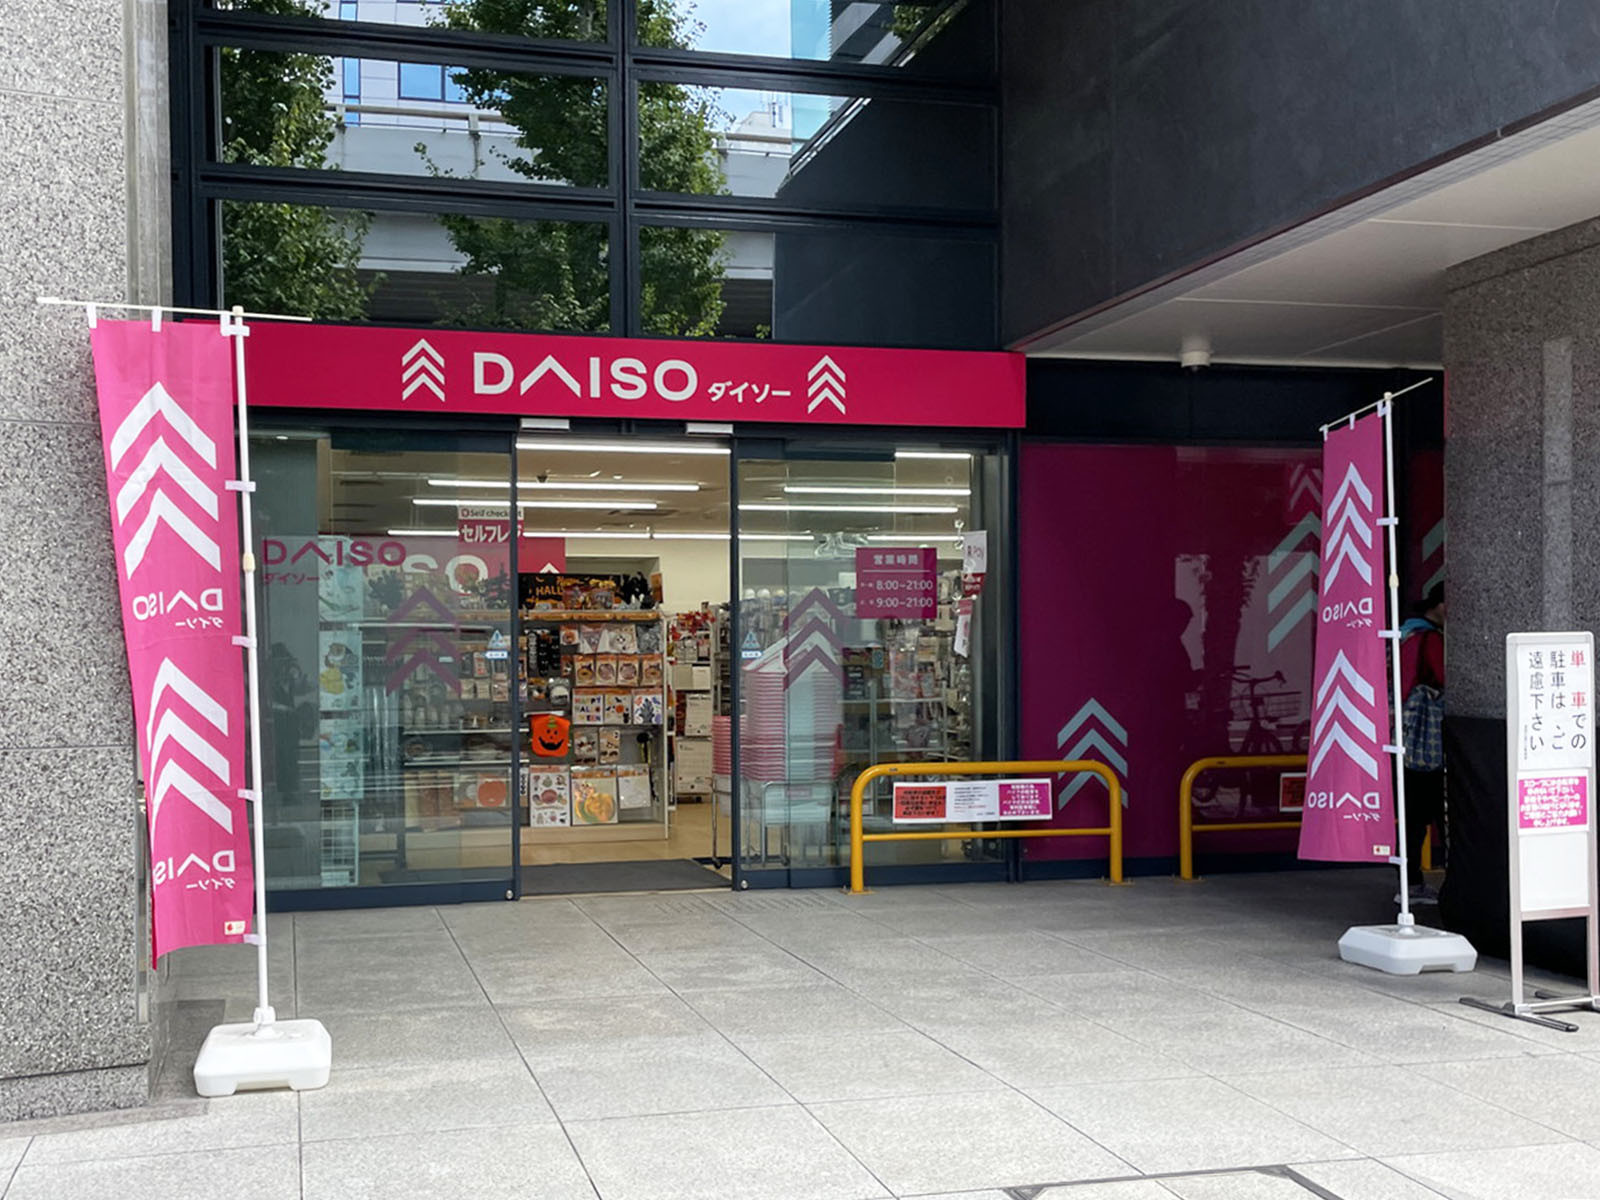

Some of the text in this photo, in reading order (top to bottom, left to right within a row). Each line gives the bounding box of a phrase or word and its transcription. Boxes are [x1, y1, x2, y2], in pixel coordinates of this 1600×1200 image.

[473, 351, 698, 401] DAISO
[707, 381, 792, 402] ダイソー
[262, 539, 407, 567] DAISO
[263, 571, 320, 586] ダイソー
